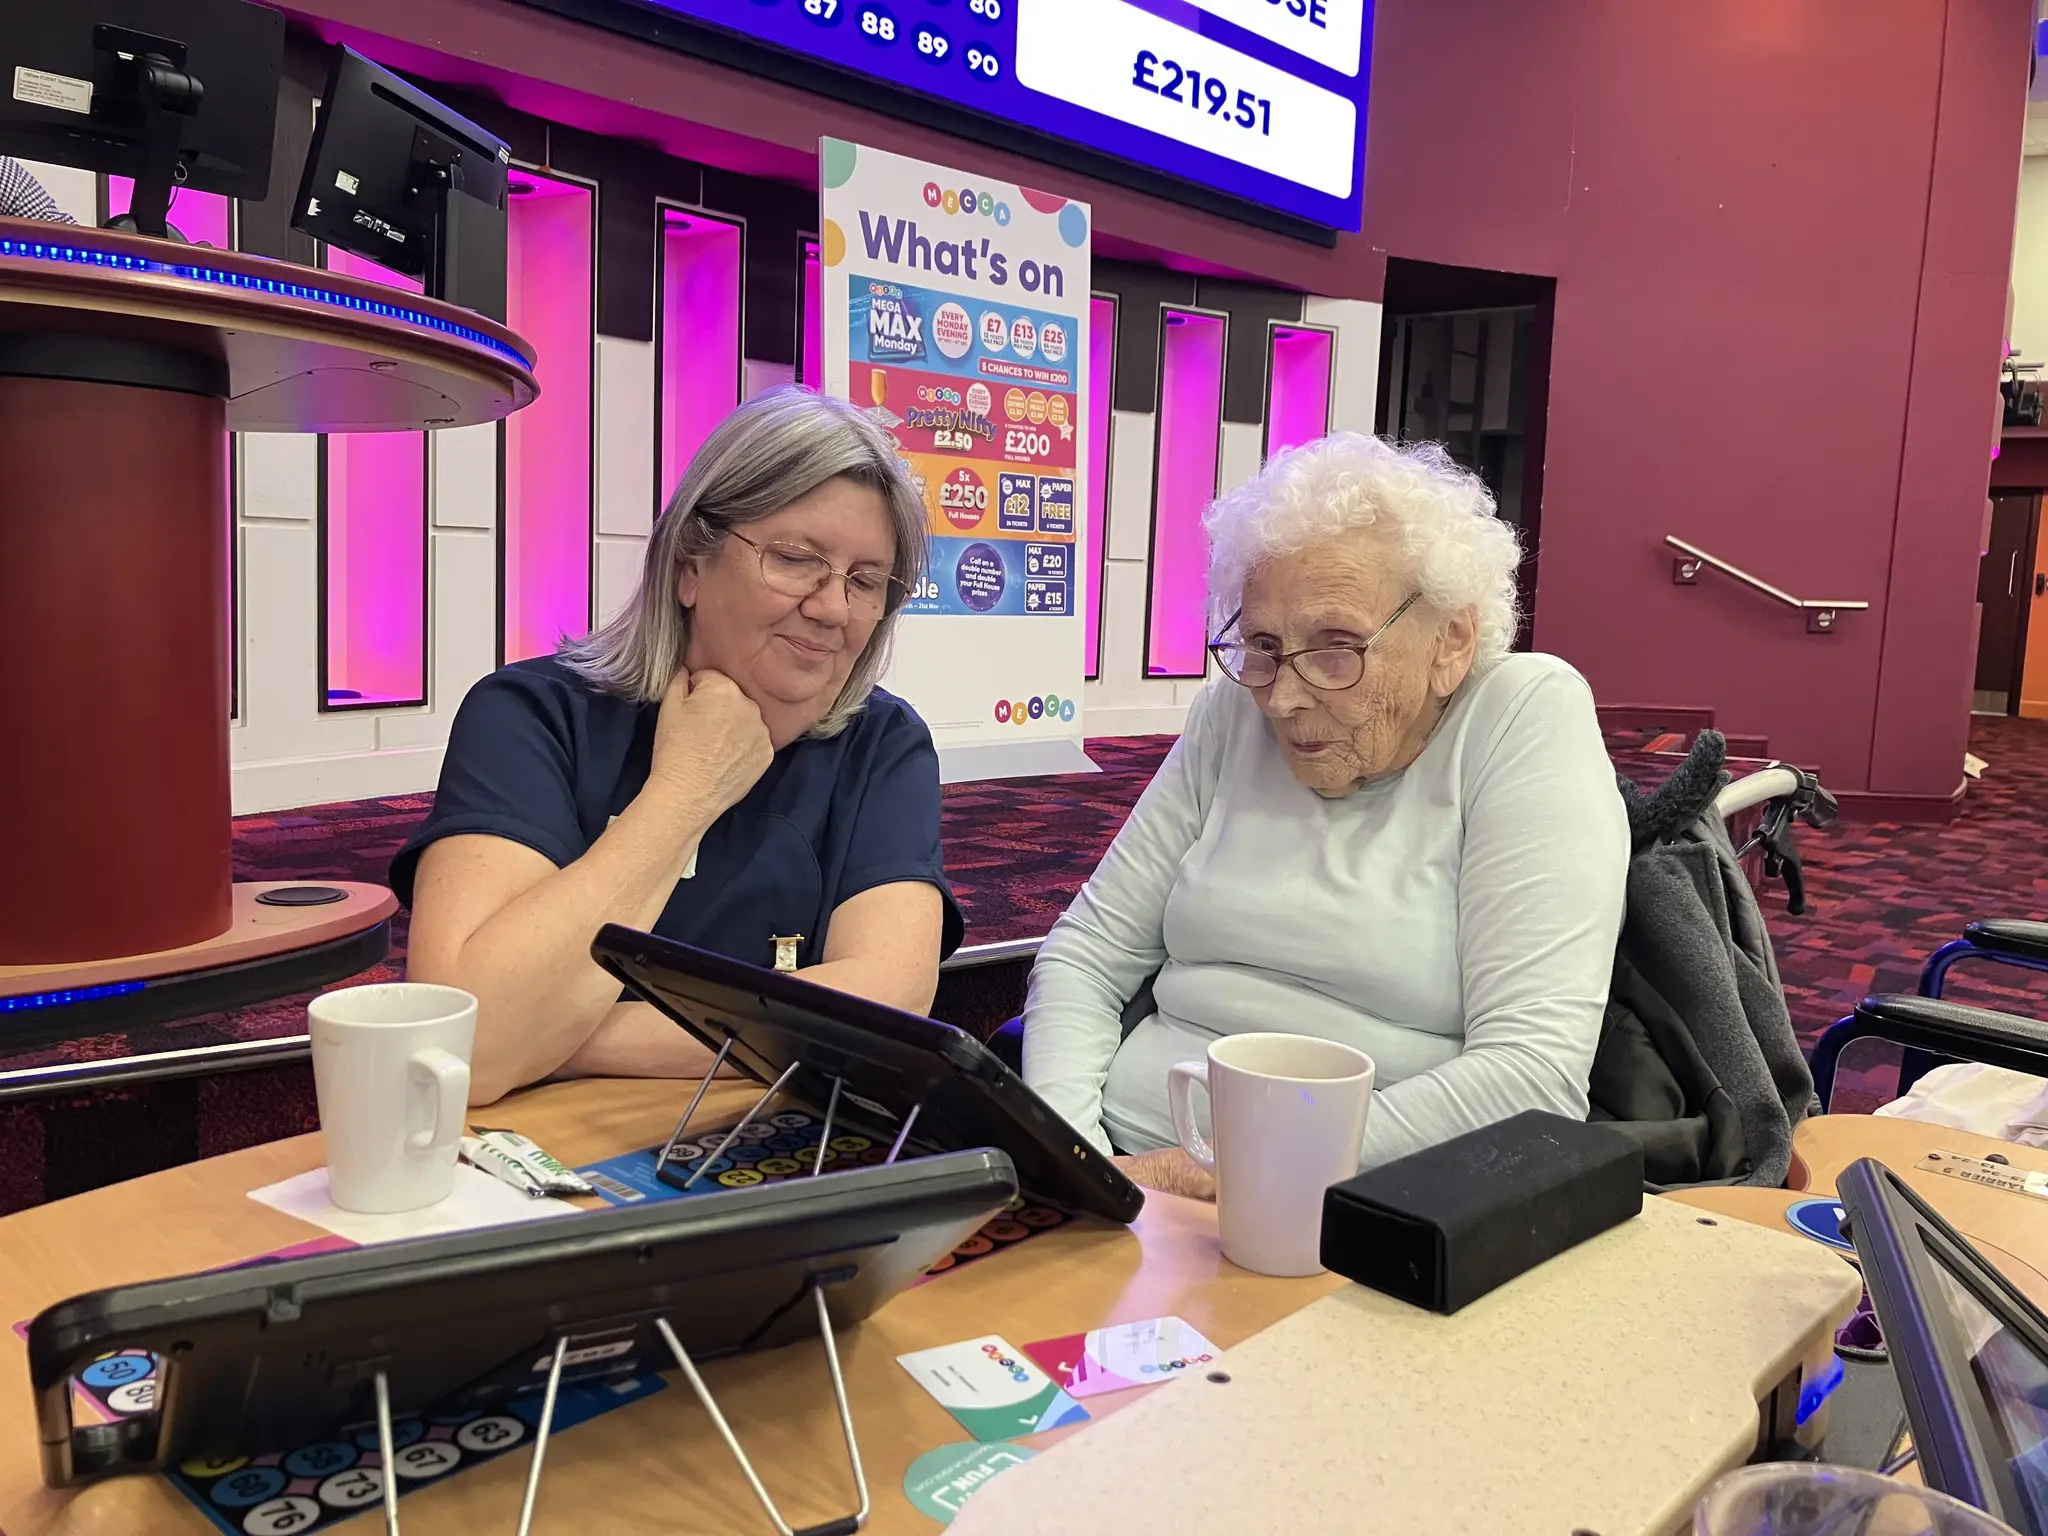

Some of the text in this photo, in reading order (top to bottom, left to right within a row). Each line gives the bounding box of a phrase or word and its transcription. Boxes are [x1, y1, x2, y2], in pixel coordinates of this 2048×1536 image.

[861, 11, 895, 40] 88
[917, 31, 949, 58] 89
[967, 48, 999, 76] 90
[1132, 49, 1271, 136] £219.51
[925, 185, 1009, 224] MECCA
[858, 209, 1064, 297] What's on
[872, 298, 902, 313] MEGA
[869, 309, 923, 341] MAX
[937, 319, 969, 331] MONDAY
[941, 310, 965, 321] EVERY
[937, 328, 969, 341] EVENING
[986, 318, 1001, 333] £7
[1014, 323, 1034, 340] £13
[874, 334, 918, 355] Monday
[1044, 329, 1063, 345] £25
[981, 362, 1067, 384] 5 CHANCES TO WIN £200
[918, 385, 961, 406] MECCA
[906, 405, 997, 442] Pretty Nifty
[934, 430, 973, 451] £2.50
[1005, 430, 1051, 456] £200
[958, 470, 970, 482] 5x
[1015, 479, 1031, 488] MAX
[939, 482, 989, 510] £250
[1052, 482, 1072, 492] PAPER
[1004, 493, 1030, 517] £12
[1041, 501, 1072, 520] FREE
[948, 511, 980, 520] Full Houses
[1028, 546, 1042, 555] MAX
[961, 563, 1002, 576] double number
[970, 557, 981, 565] Call
[1042, 554, 1062, 568] £20
[973, 580, 983, 588] Full
[983, 582, 1001, 591] House
[977, 573, 996, 583] double
[1027, 583, 1046, 591] PAPER
[1044, 591, 1062, 605] £15
[997, 696, 1073, 723] MECCA
[1961, 1171, 2025, 1190] ARRIER
[100, 1361, 136, 1380] 50
[470, 1421, 510, 1446] 63
[404, 1447, 448, 1469] 67
[334, 1472, 380, 1499] 73
[955, 1463, 996, 1492] FUN
[260, 1501, 305, 1529] 76
